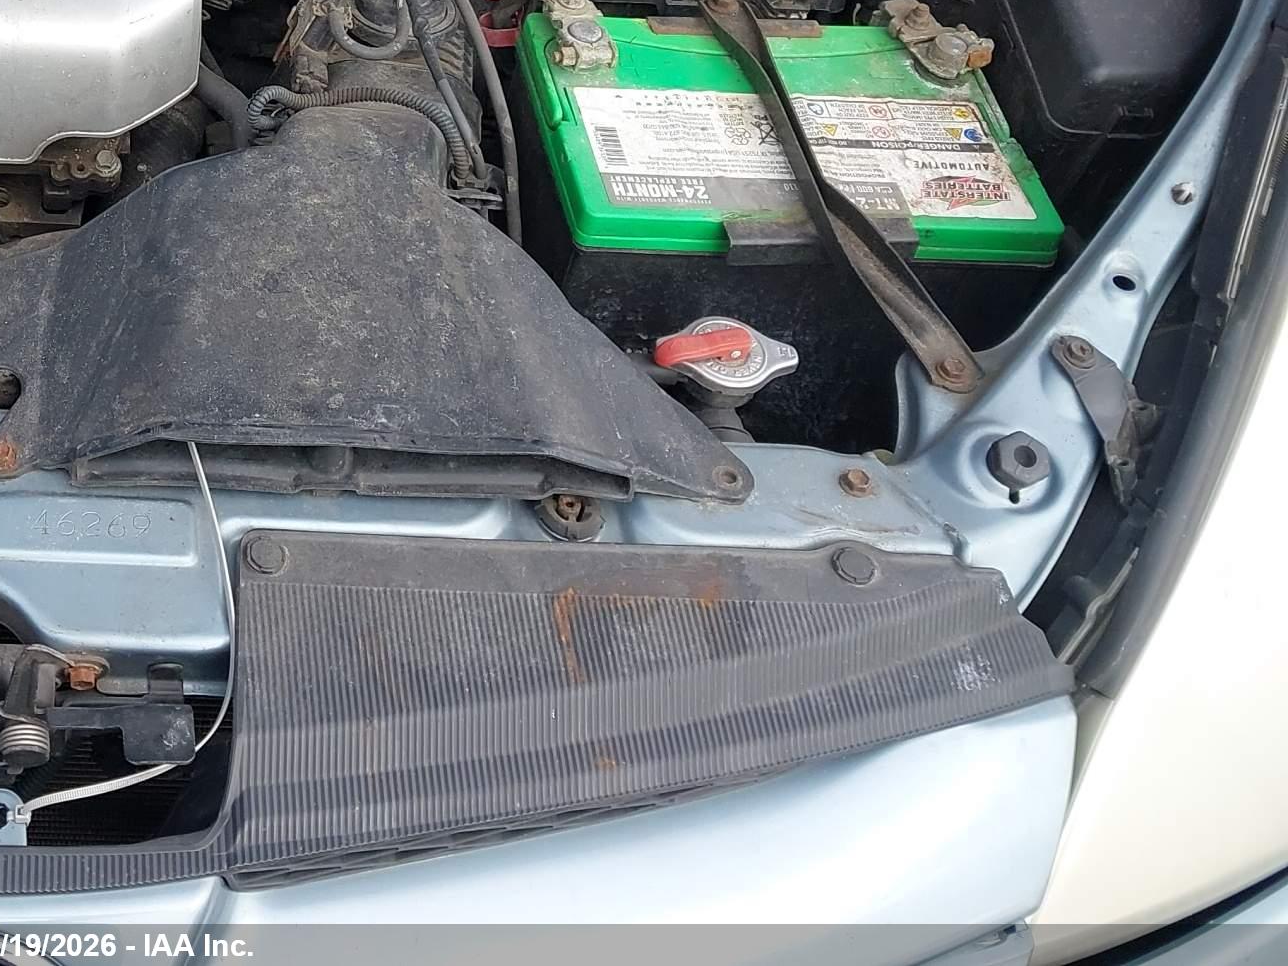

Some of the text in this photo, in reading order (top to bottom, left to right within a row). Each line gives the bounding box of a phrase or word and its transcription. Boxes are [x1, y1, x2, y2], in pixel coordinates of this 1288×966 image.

[913, 160, 990, 171] AUTOMOTIVE
[608, 175, 704, 186] FREE REPLACEMENT
[611, 182, 709, 200] 24-MONTH
[925, 182, 1001, 192] BATTERIES
[923, 190, 1009, 200] INTERSTATE
[31, 508, 152, 538] 46269
